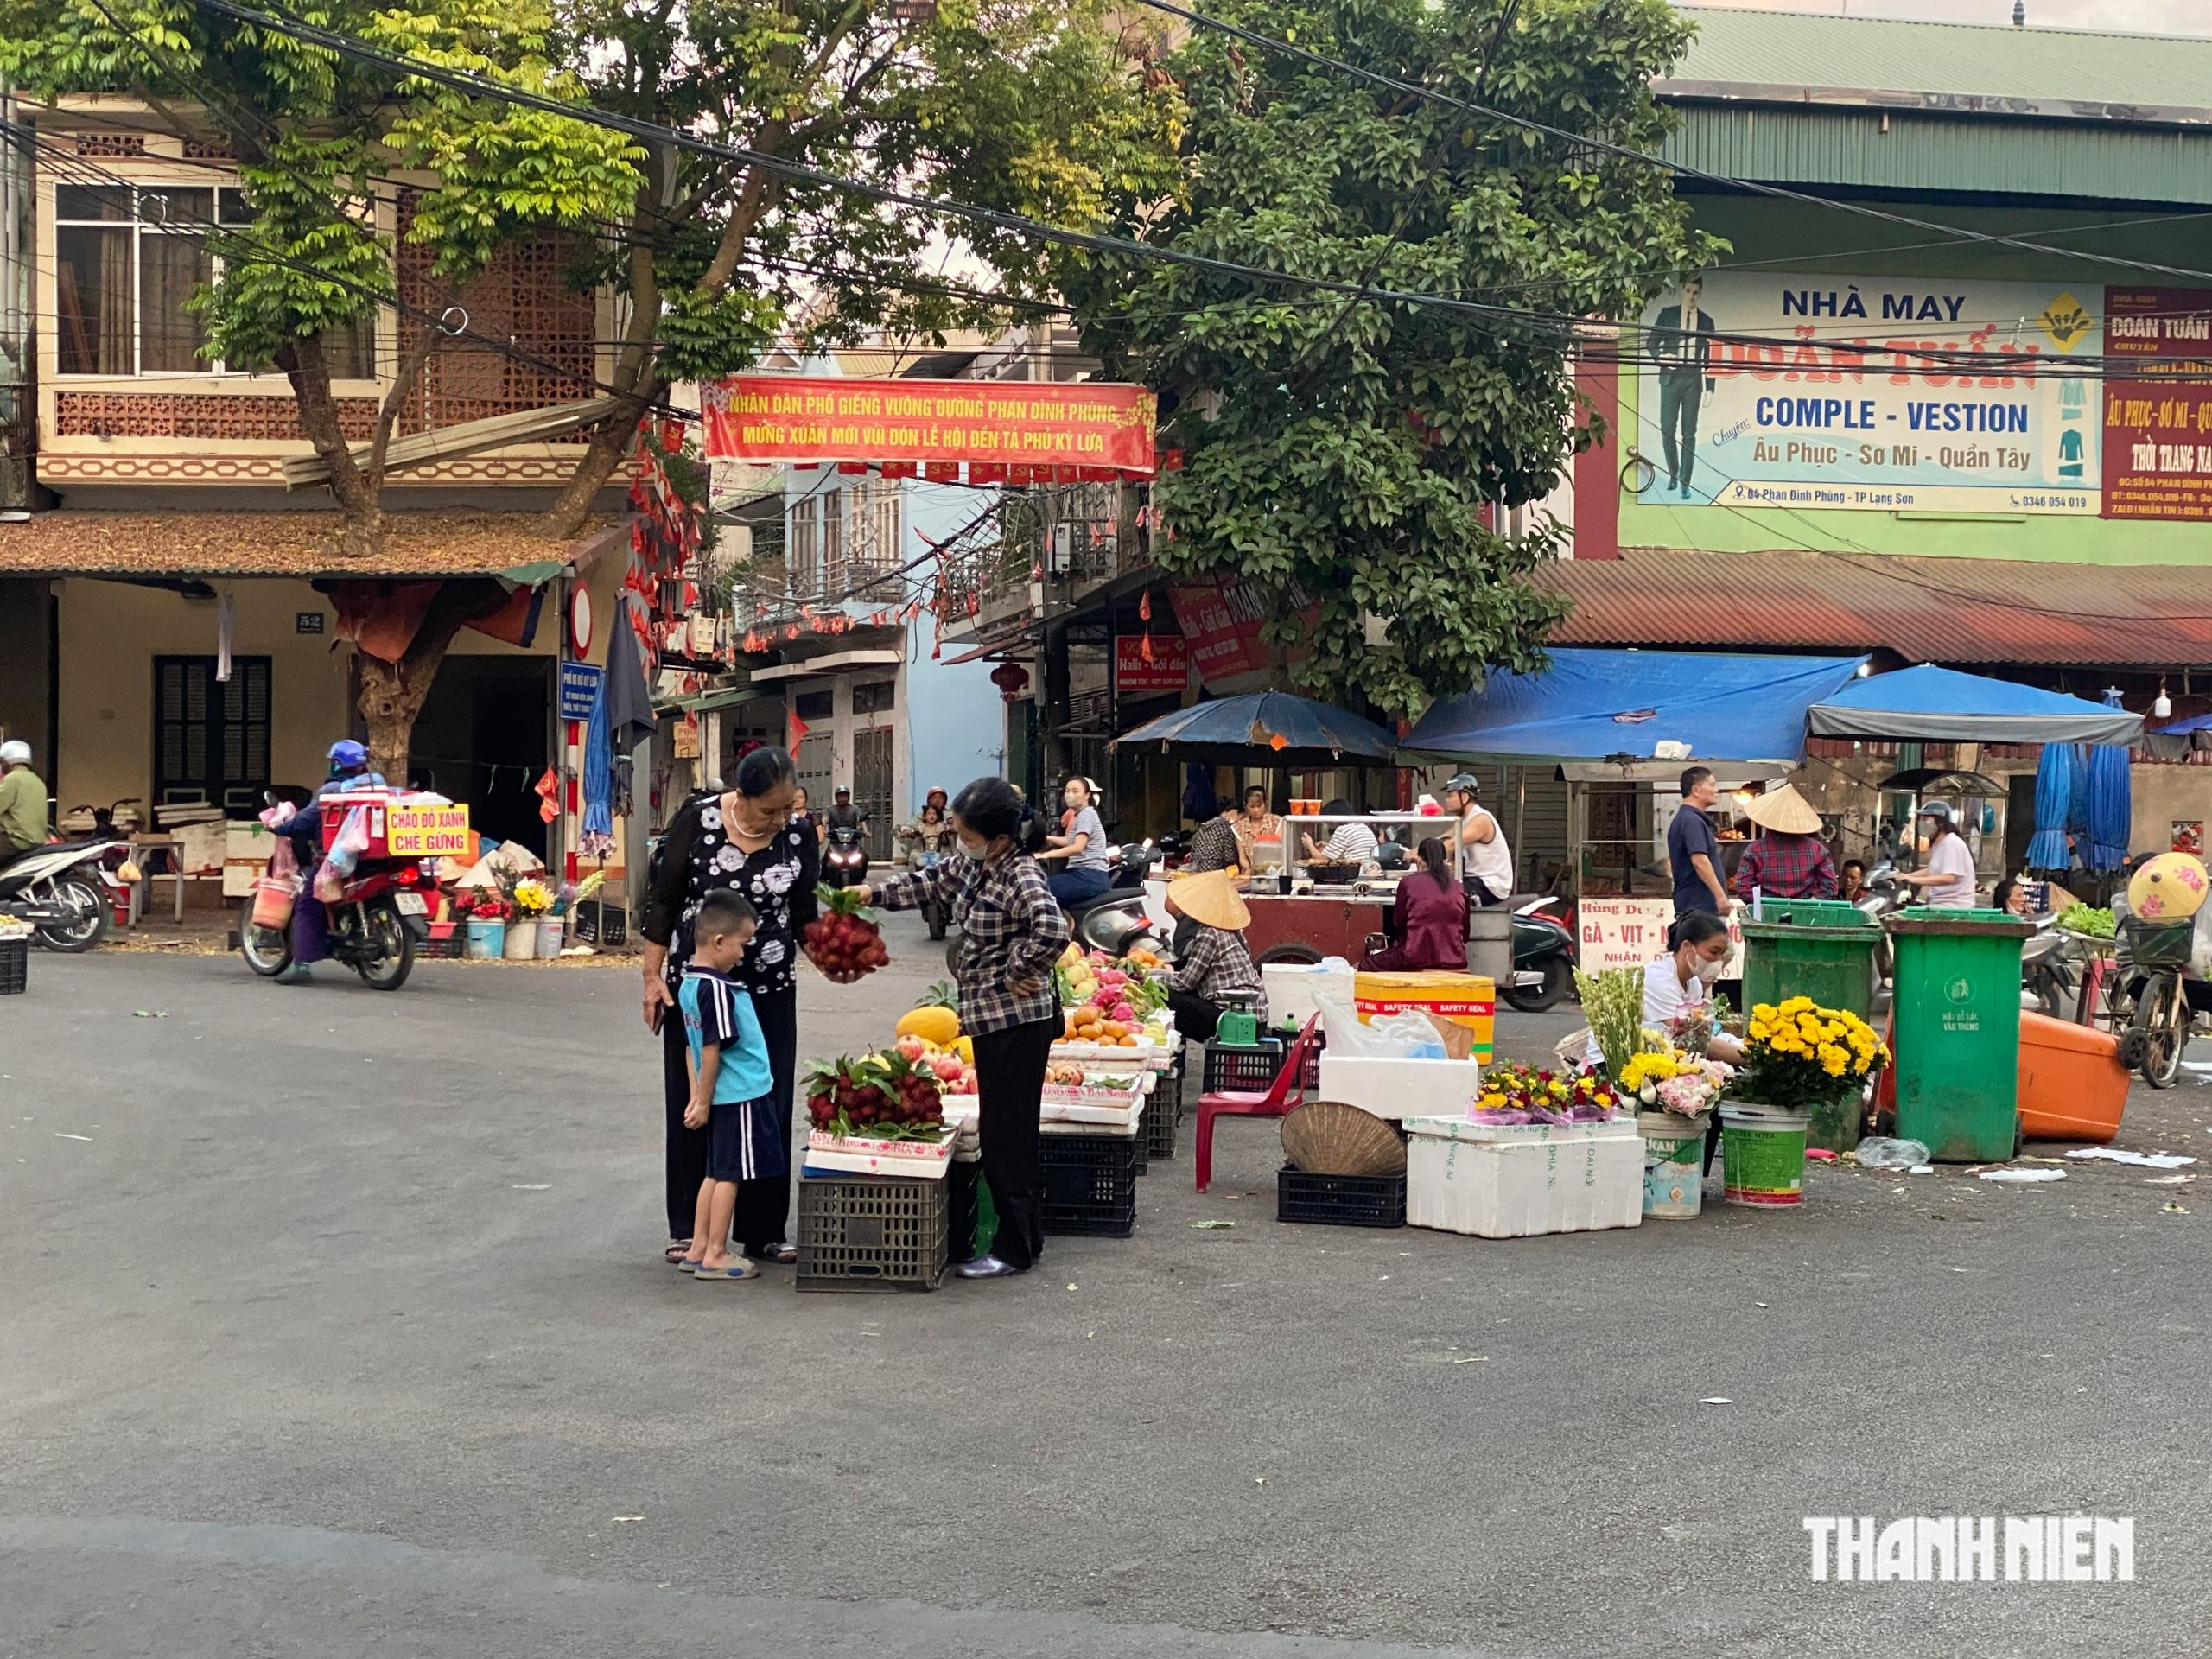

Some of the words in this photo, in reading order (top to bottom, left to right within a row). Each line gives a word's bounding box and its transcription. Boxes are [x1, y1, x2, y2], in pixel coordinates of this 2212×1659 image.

[1783, 284, 1867, 318] NHÀ
[1882, 294, 1966, 321] MAY
[1707, 324, 1866, 383] DOÃN
[1885, 323, 2041, 389] TUẤN
[729, 392, 768, 414] NHÂN
[772, 392, 802, 414] DÂN
[806, 391, 834, 416] PHỐ
[839, 391, 880, 416] GIẾNG
[885, 395, 931, 417] VUÔNG
[936, 397, 983, 418] ĐƯỜNG
[988, 400, 1027, 420] PHAN
[1031, 399, 1065, 421] ĐÌNH
[1069, 401, 1116, 423] PHÙNG
[1756, 397, 1875, 429] COMPLE
[1907, 401, 2028, 433] VESTION
[2107, 392, 2122, 426] ÂU
[743, 420, 784, 444] MỪNG
[789, 422, 827, 444] XUÂN
[831, 421, 858, 445] MỚI
[862, 427, 885, 445] VUI
[889, 423, 918, 446] ĐÓN
[923, 423, 938, 447] LỄ
[943, 425, 965, 450] HỘI
[970, 424, 998, 448] ĐỀN
[1002, 425, 1019, 448] TẢ
[1024, 427, 1052, 450] PHỦ
[1056, 430, 1072, 451] KỲ
[1077, 431, 1103, 452] LỪA
[1712, 418, 1750, 447] Chuyên:
[1753, 436, 1779, 463] Âu
[1787, 442, 1837, 468] Phục
[1859, 444, 1885, 465] Sơ
[1892, 445, 1917, 466] Mi
[1939, 442, 1990, 468] Quần
[1997, 447, 2031, 471] Tây
[2160, 444, 2194, 472] TRANG
[1763, 489, 1787, 500] Phan
[1790, 489, 1811, 501] Đình
[1815, 490, 1845, 504] Phùng
[1855, 493, 1866, 503] TP
[1870, 493, 1892, 506] Lạng
[1896, 493, 1914, 504] Sơn
[2023, 496, 2045, 506] 0346
[2049, 496, 2066, 507] 054
[2069, 497, 2087, 507] 019
[1119, 658, 1141, 671] Nails
[439, 812, 465, 827] XANH
[395, 832, 421, 850] CHÈ
[427, 831, 464, 849] GỪNG
[1581, 901, 1619, 915] Hùng
[1583, 922, 1603, 944] GÀ
[1621, 925, 1643, 947] VỊT
[1605, 951, 1641, 964] NHẬN
